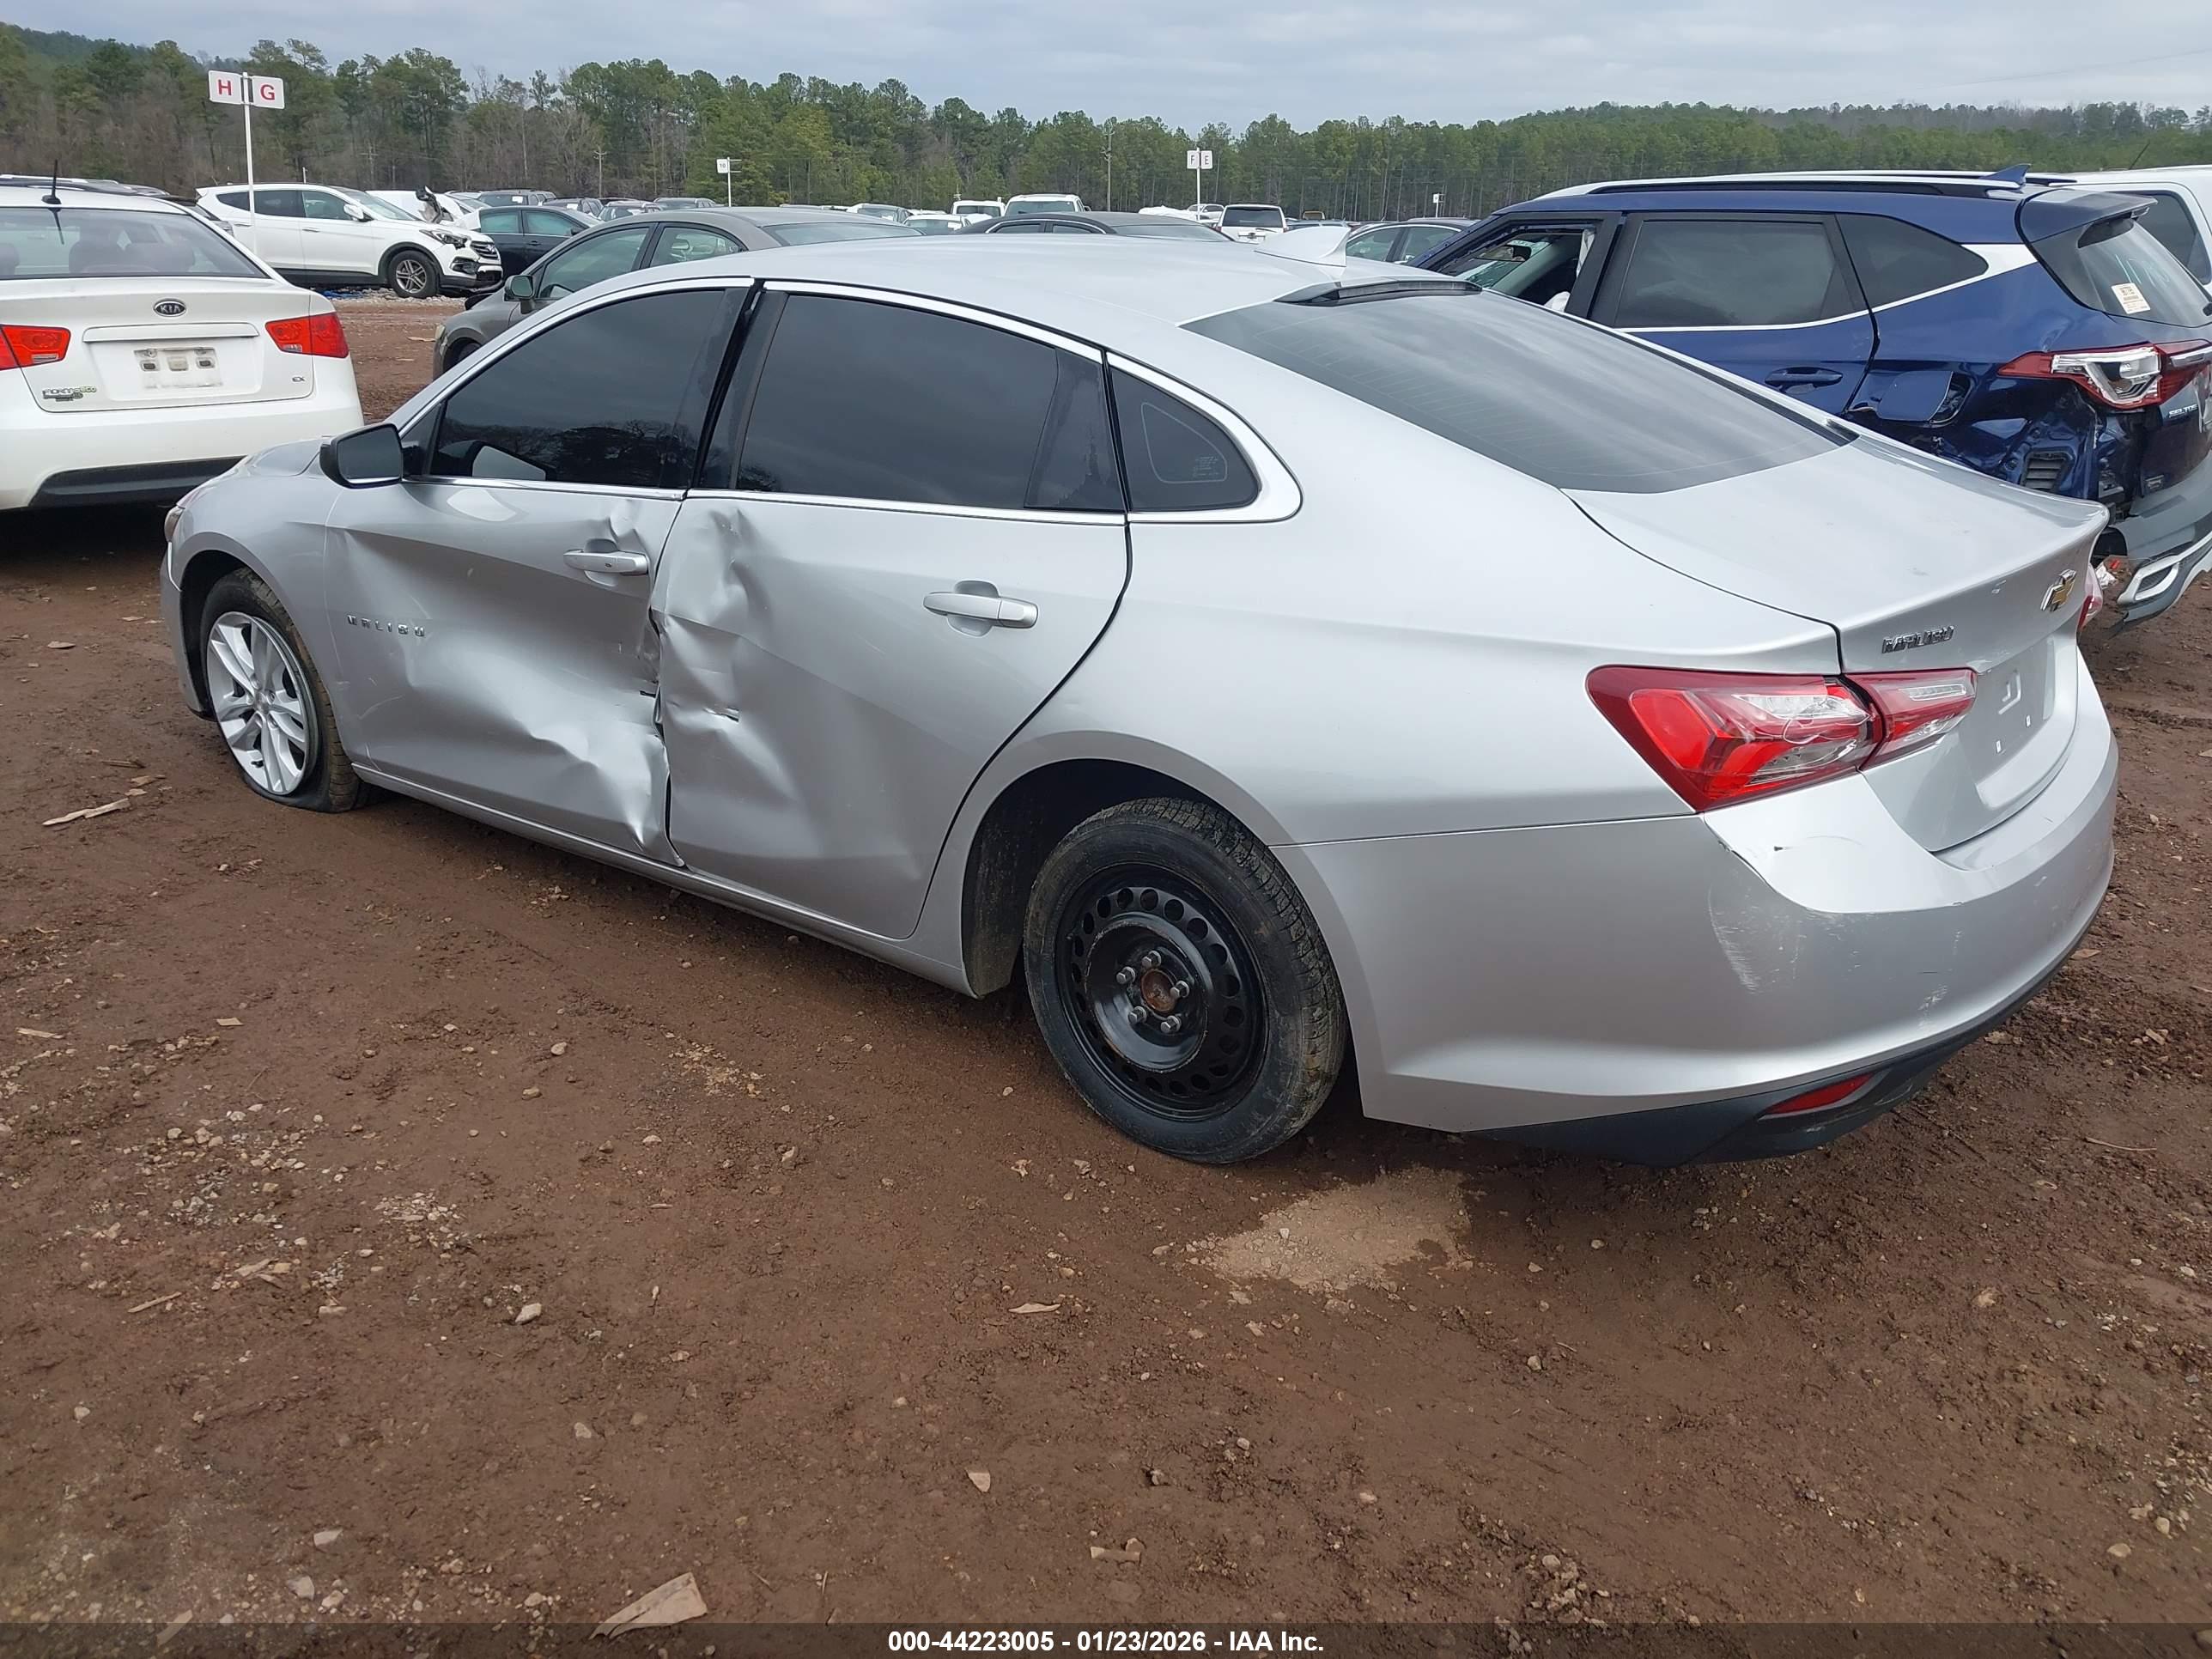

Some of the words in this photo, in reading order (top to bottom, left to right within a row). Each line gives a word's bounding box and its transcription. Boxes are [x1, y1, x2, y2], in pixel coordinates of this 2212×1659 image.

[217, 79, 232, 96] H
[260, 84, 276, 100] G
[1190, 155, 1195, 165] F
[1204, 155, 1209, 165] E
[160, 304, 181, 313] KIA
[2168, 404, 2198, 418] SELTOS
[1881, 625, 1954, 653] MALIBU
